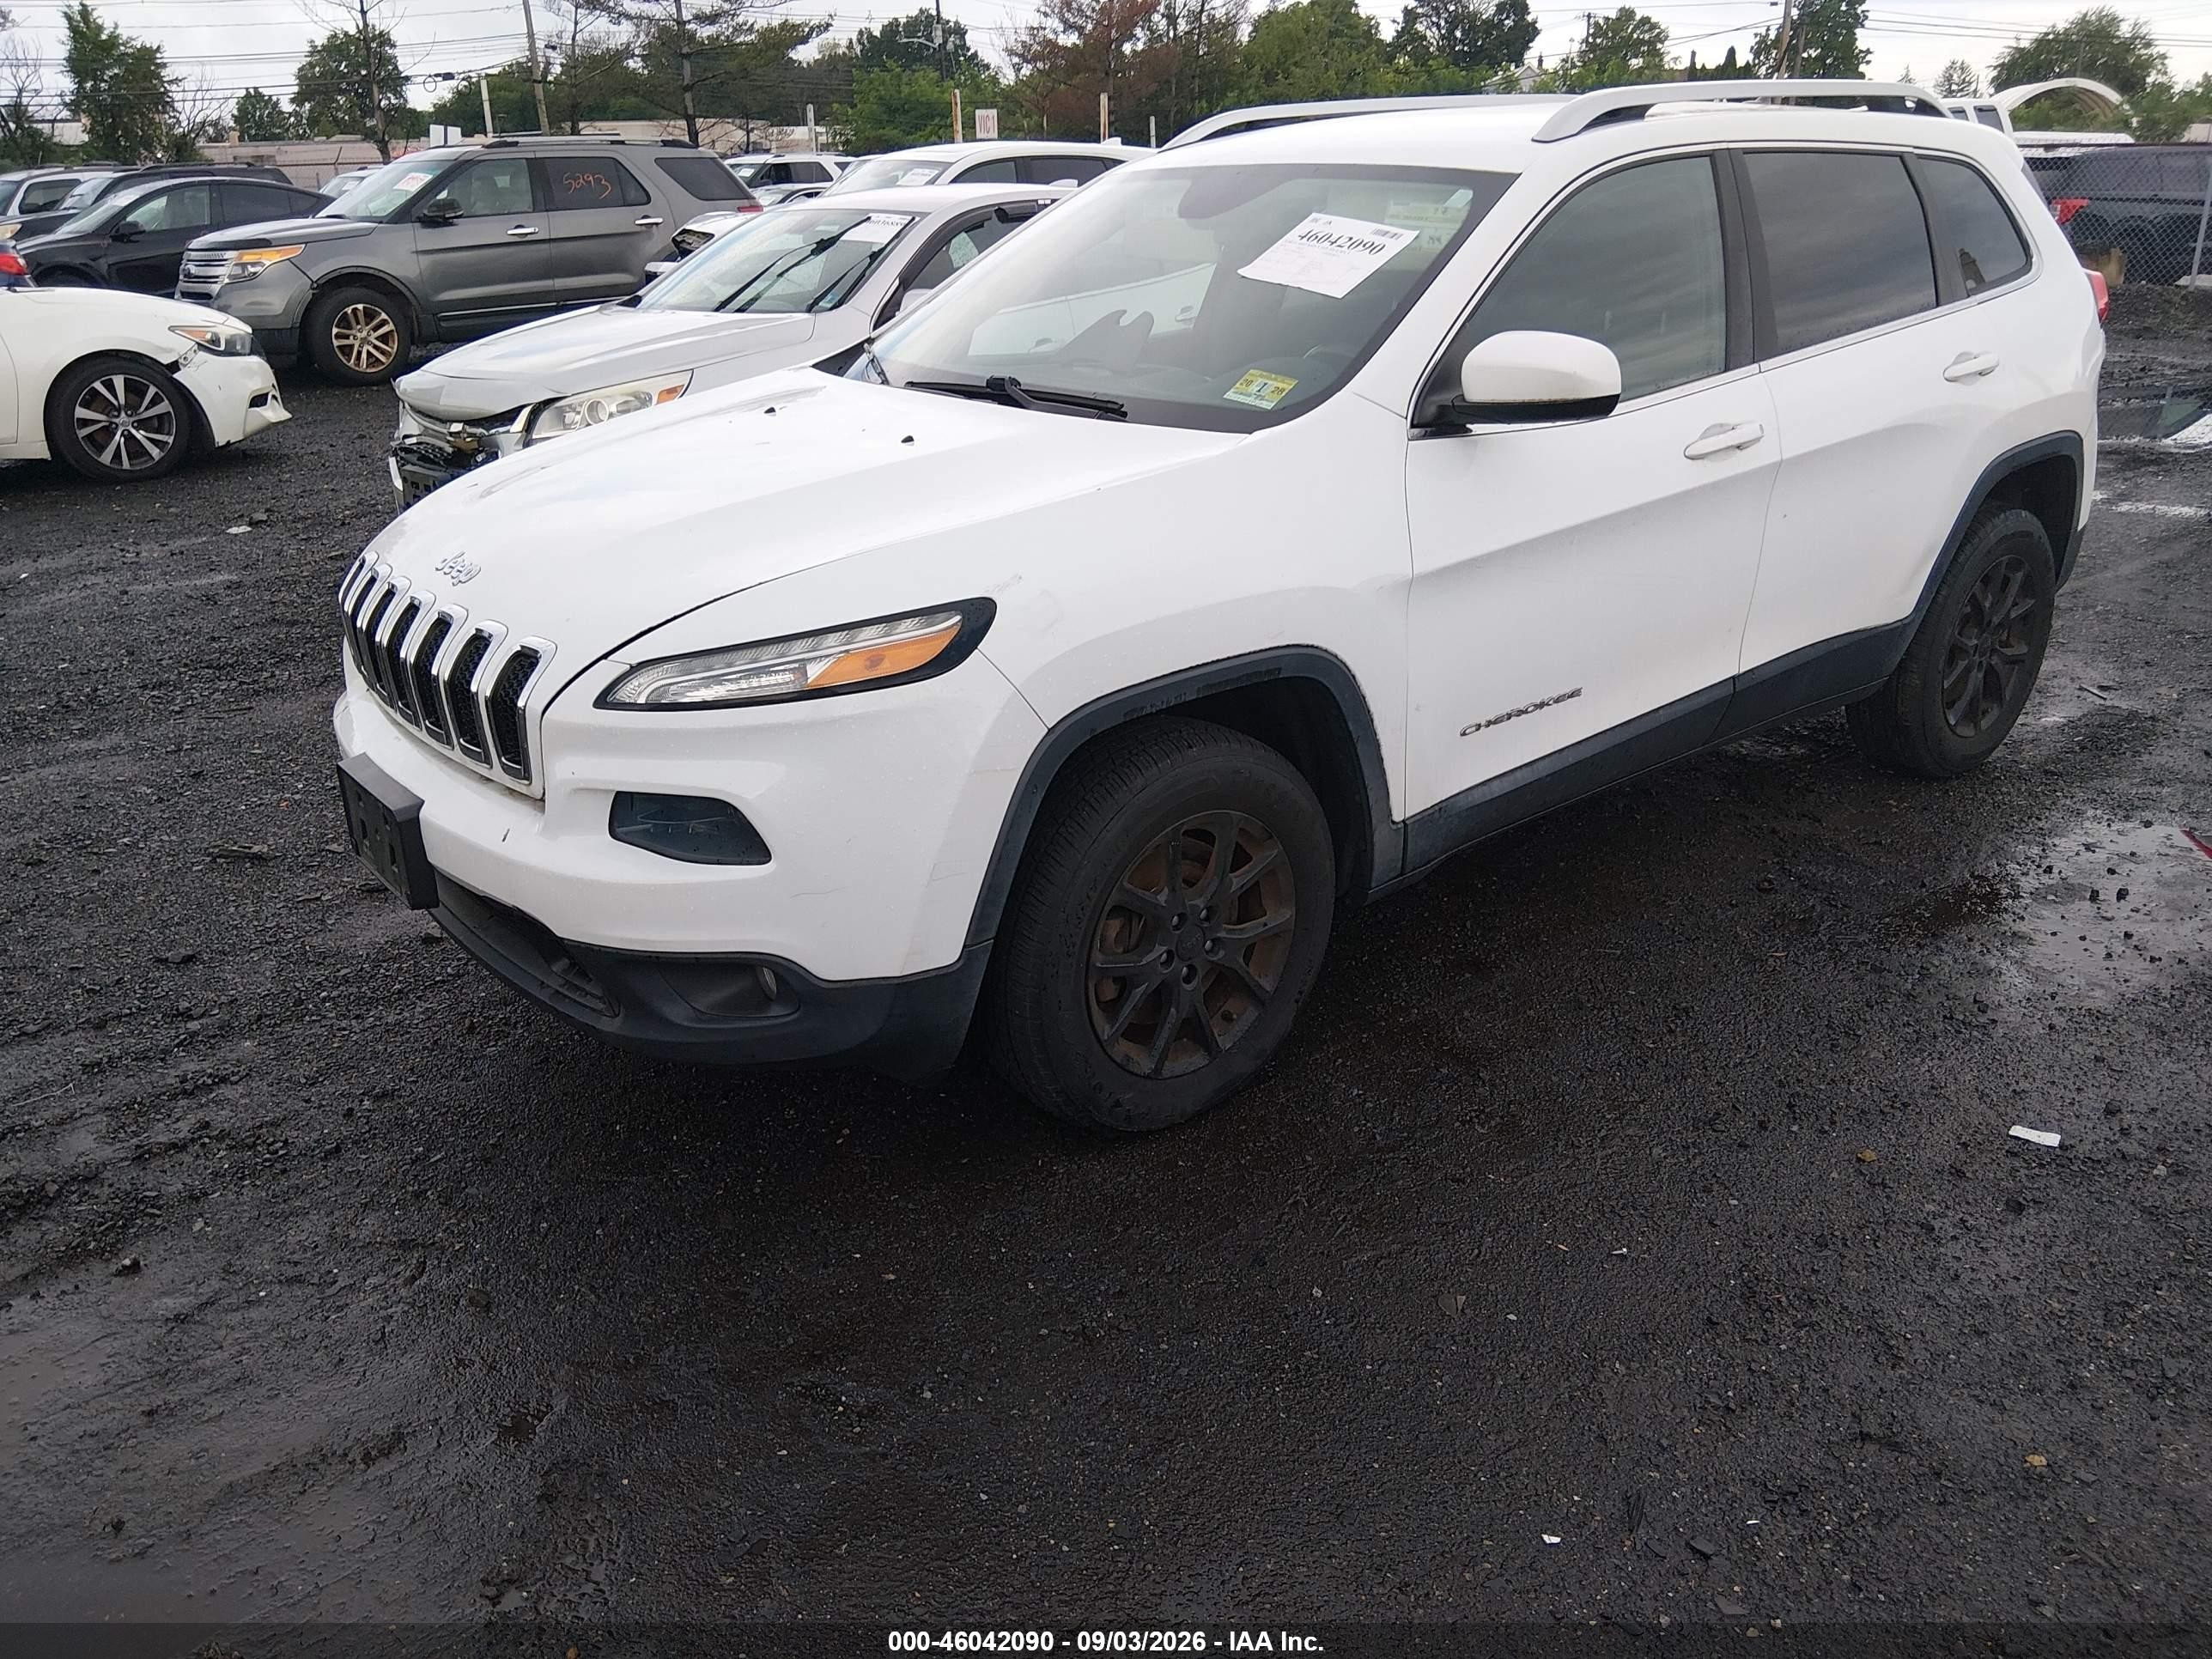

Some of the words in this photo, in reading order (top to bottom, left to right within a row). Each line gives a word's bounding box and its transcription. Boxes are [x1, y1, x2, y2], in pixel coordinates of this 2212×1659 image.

[563, 172, 611, 199] 5293
[1297, 228, 1386, 255] 46042090
[1256, 381, 1268, 392] 1
[434, 550, 482, 586] Jeep
[1460, 687, 1583, 736] CHEROKEE
